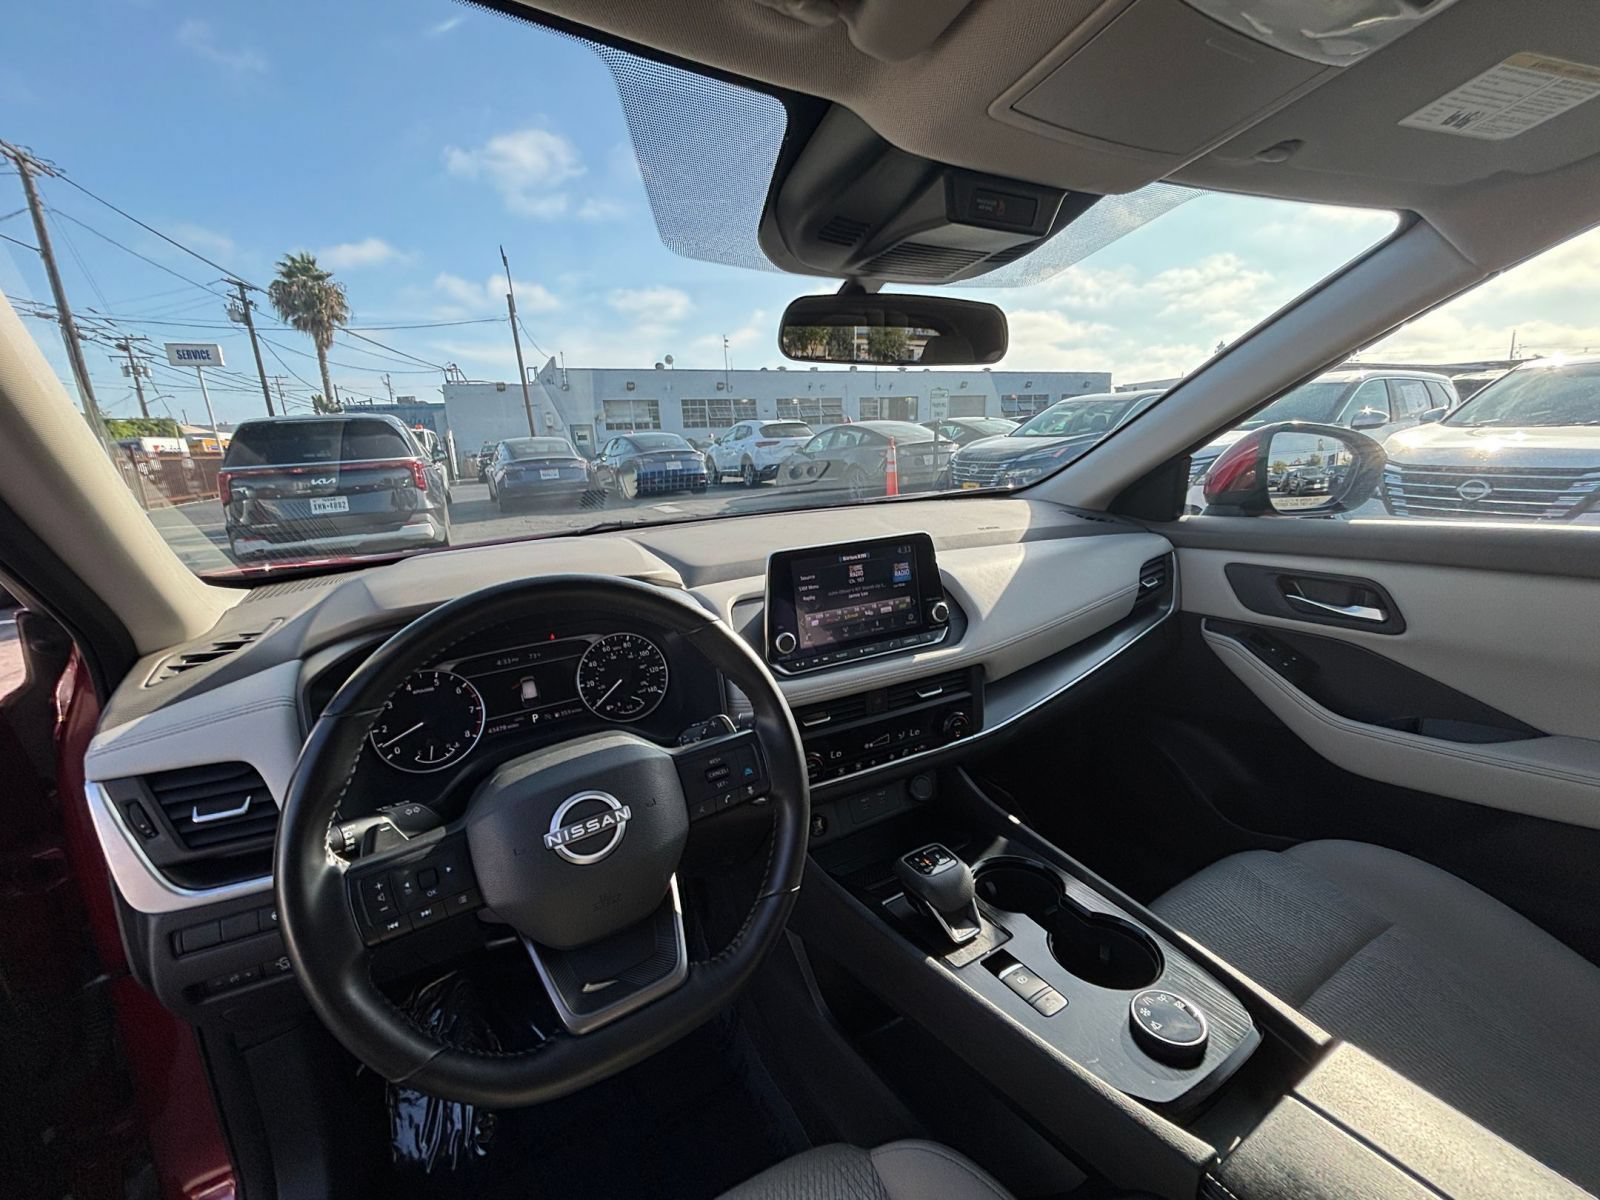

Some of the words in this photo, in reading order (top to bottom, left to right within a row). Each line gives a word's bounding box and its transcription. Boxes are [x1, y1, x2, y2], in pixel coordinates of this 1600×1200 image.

[176, 349, 212, 360] SERVICE
[433, 678, 440, 686] 5
[455, 687, 462, 695] 6
[468, 706, 474, 714] 7
[532, 713, 539, 724] P
[381, 725, 387, 733] 2
[464, 730, 470, 738] 8
[394, 747, 400, 755] 0
[547, 806, 629, 847] NISSAN
[427, 889, 437, 897] OK
